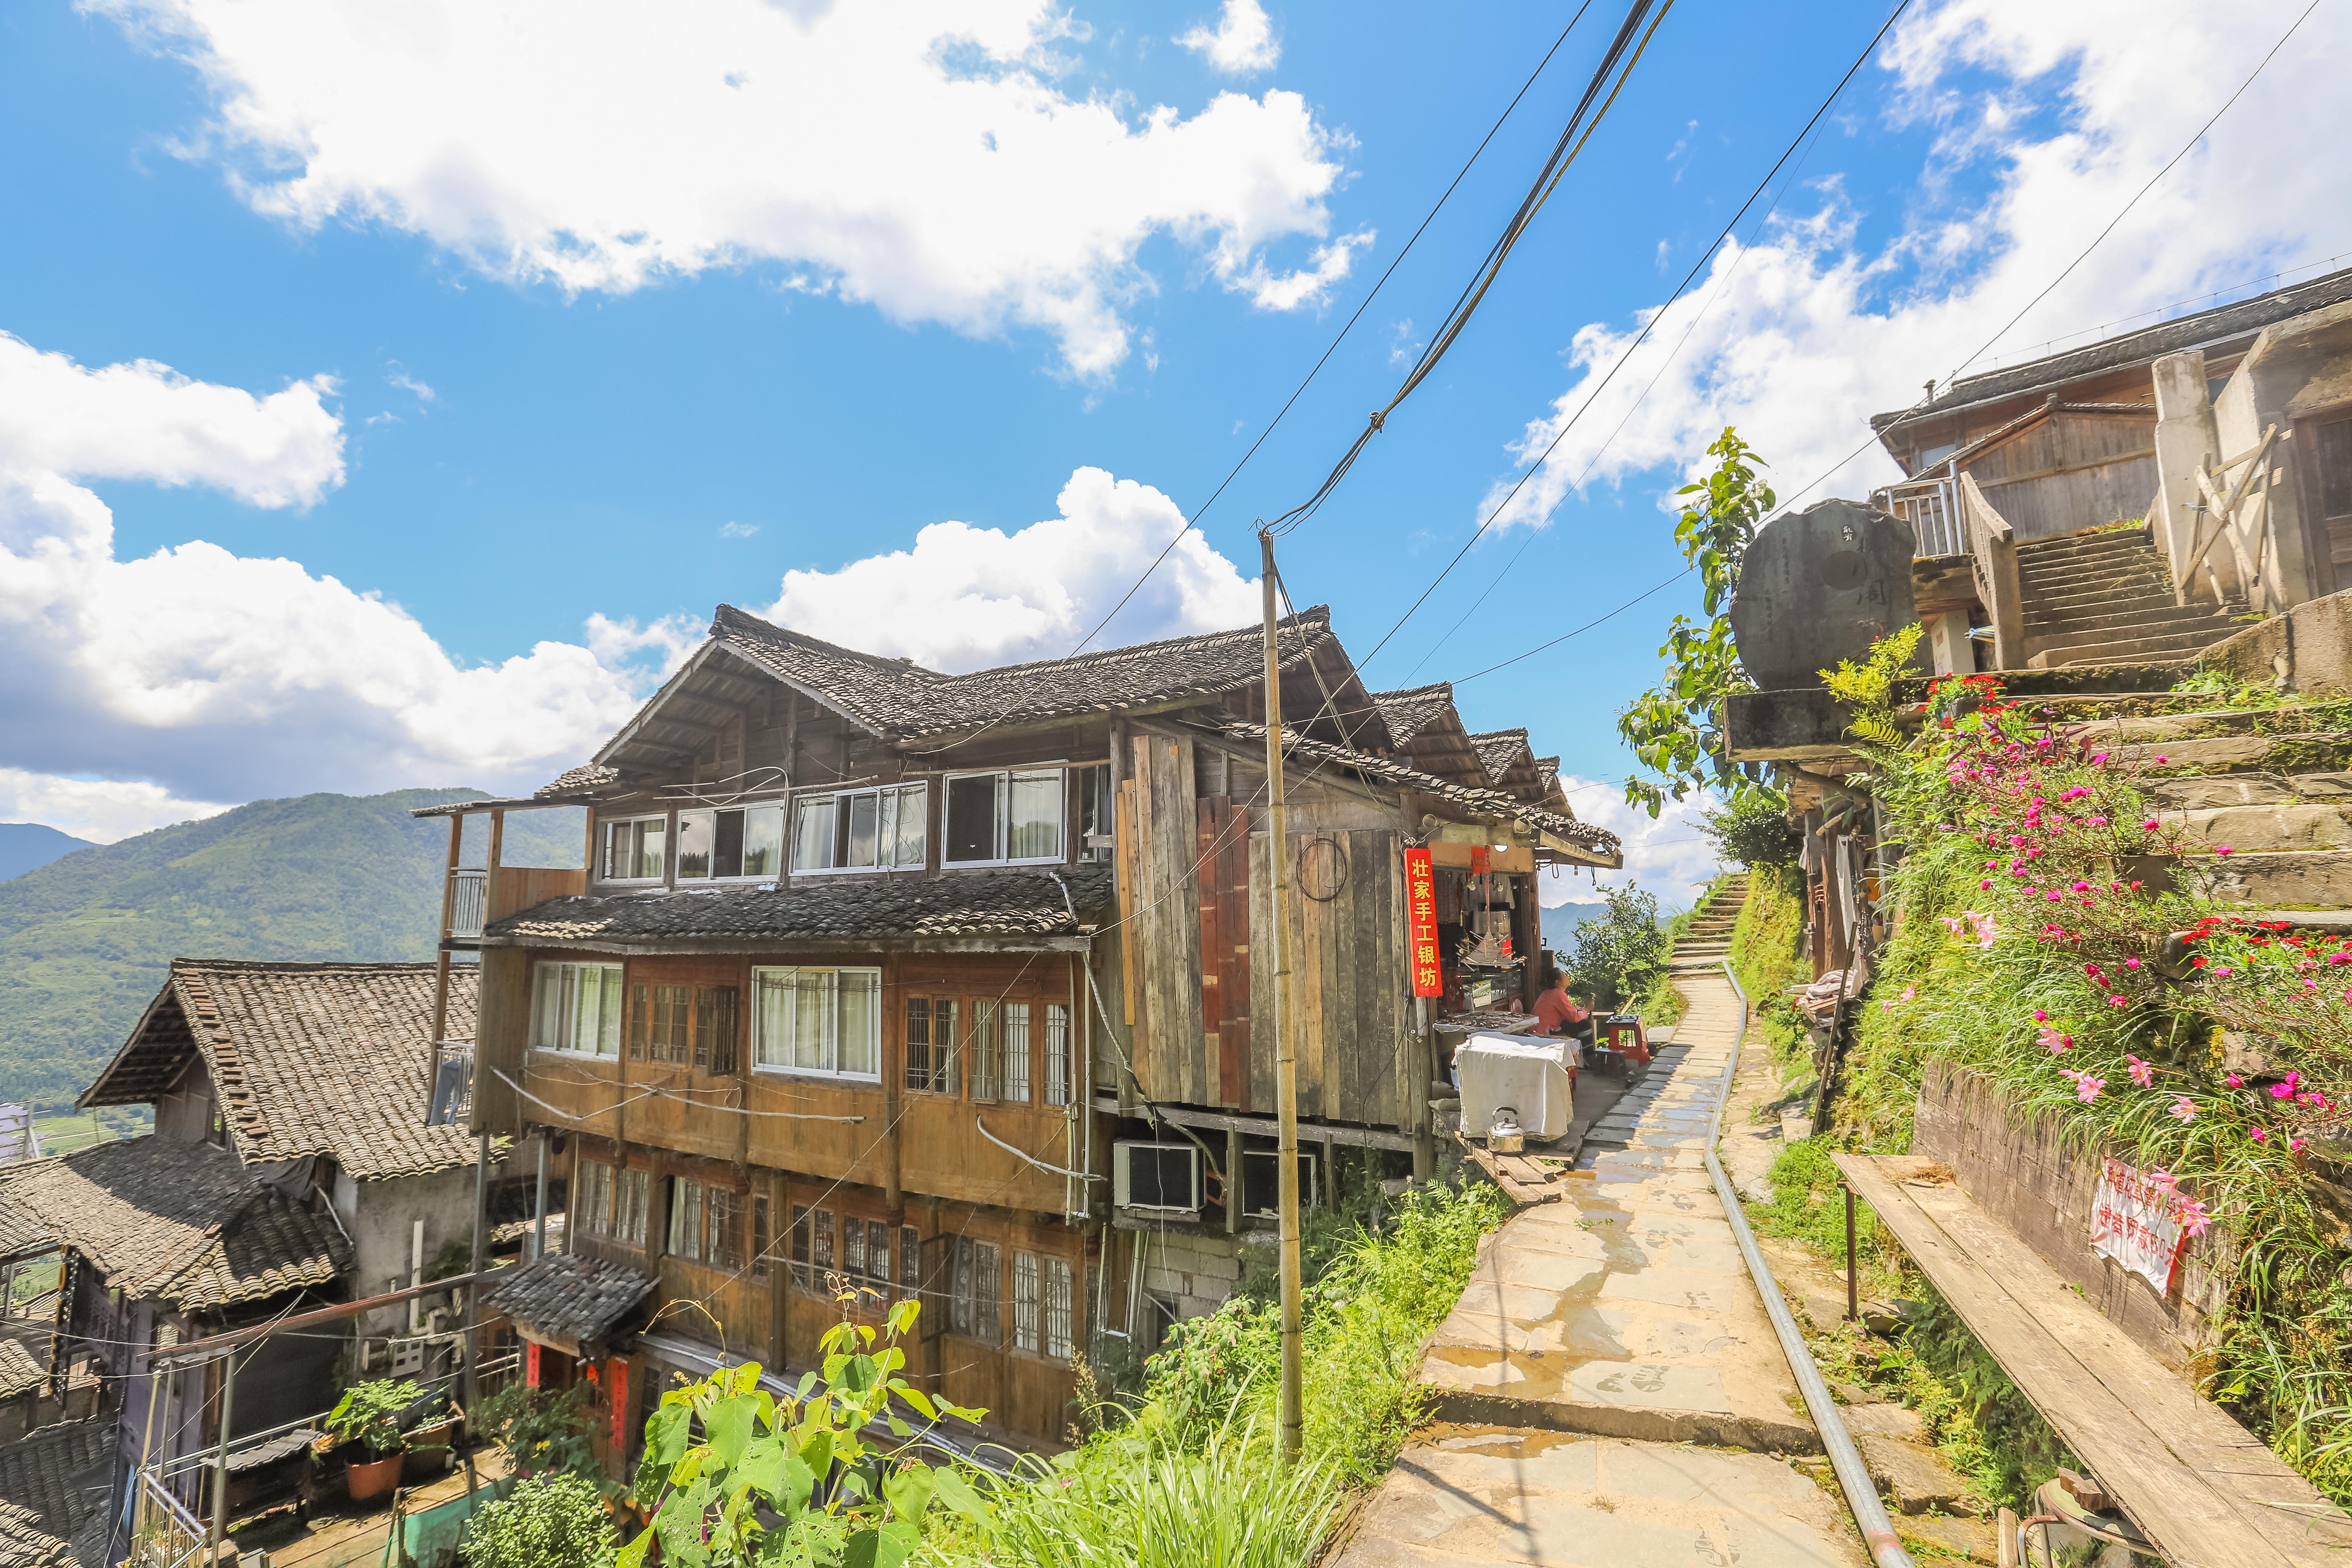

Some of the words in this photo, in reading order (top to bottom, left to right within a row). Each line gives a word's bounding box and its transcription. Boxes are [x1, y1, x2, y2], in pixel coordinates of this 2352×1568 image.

[1412, 859, 1436, 987] 壮家手工银坊
